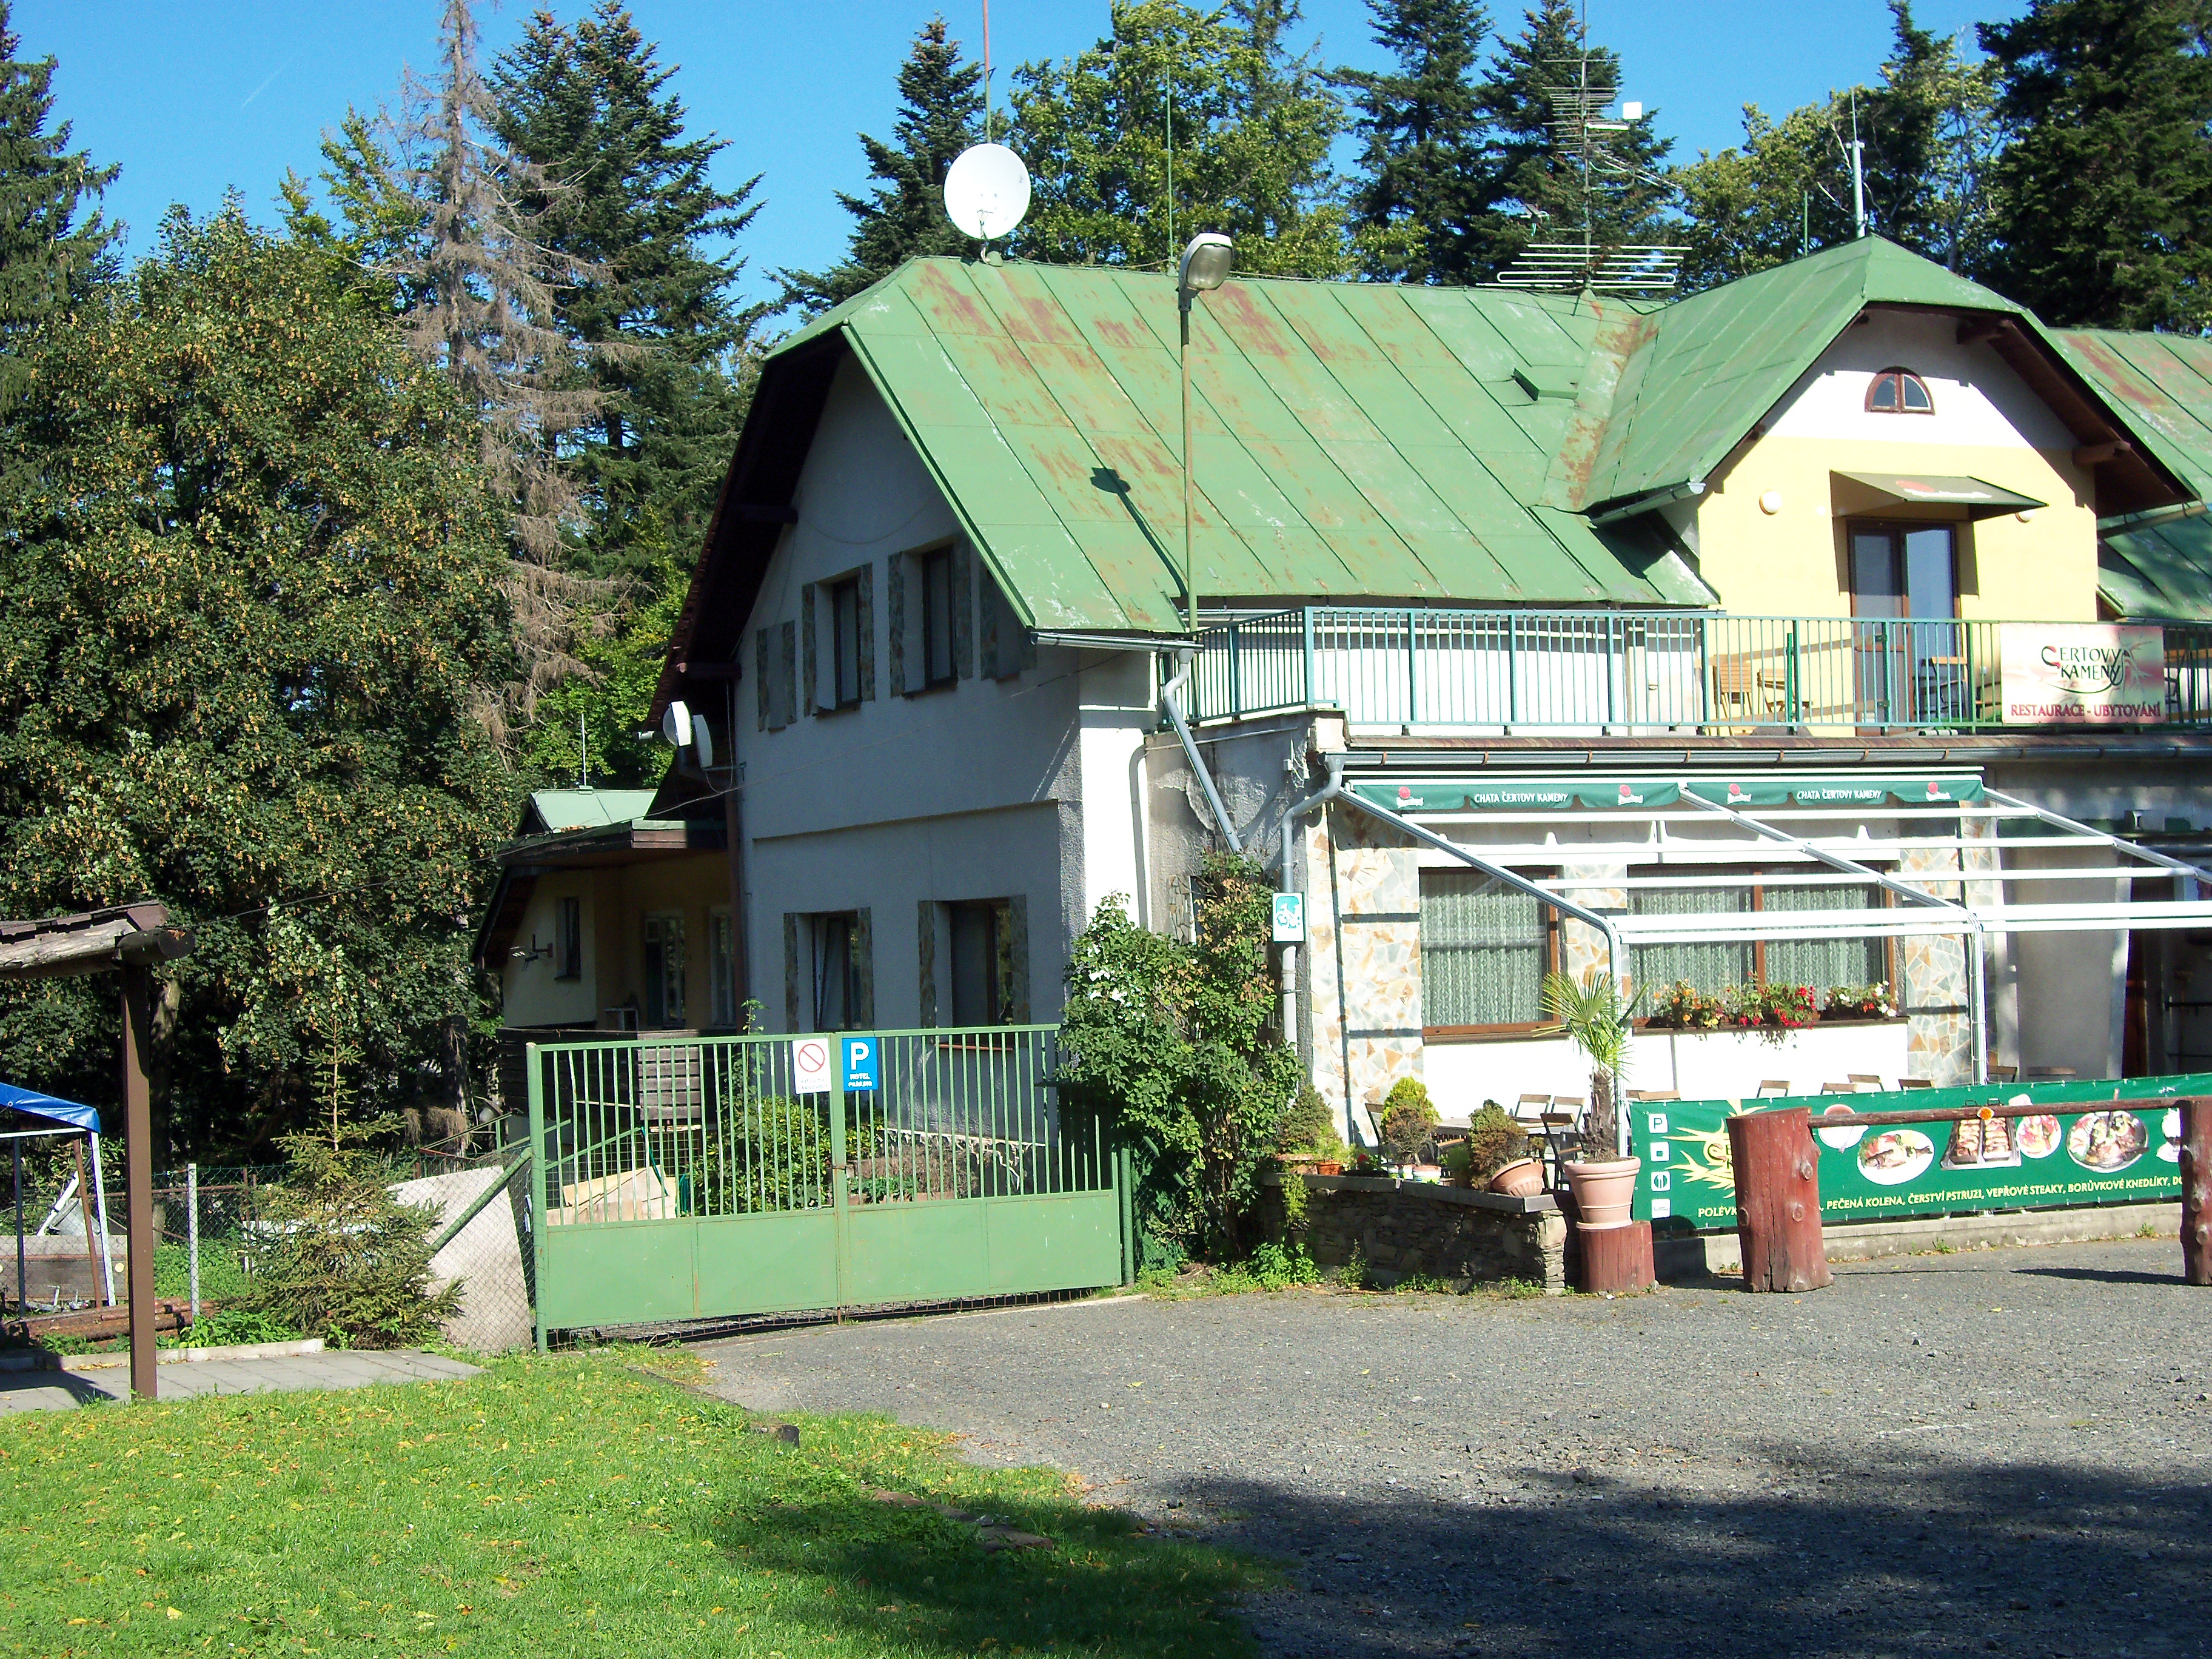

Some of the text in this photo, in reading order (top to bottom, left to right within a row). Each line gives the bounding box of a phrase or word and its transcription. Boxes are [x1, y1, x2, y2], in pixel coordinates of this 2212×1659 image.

[2061, 664, 2121, 680] KAMENY
[2011, 704, 2084, 717] RESTAURACE
[2094, 701, 2161, 717] UBYTOVÁNÍ
[1474, 791, 1569, 803] CHATA ČERTOVY KAMENY
[1797, 788, 1882, 800] CHATA ČERTOVY KAMENY
[850, 1042, 870, 1070] P
[1826, 1196, 1863, 1210] PEČENÁ
[1865, 1196, 1906, 1207] KOLENA,
[1908, 1190, 1945, 1204] ČERSTVÍ
[1986, 1184, 2029, 1198] VEPŘOVÉ
[2029, 1184, 2066, 1195] STEAKY,
[2067, 1178, 2125, 1193] BORŮVKOVÉ
